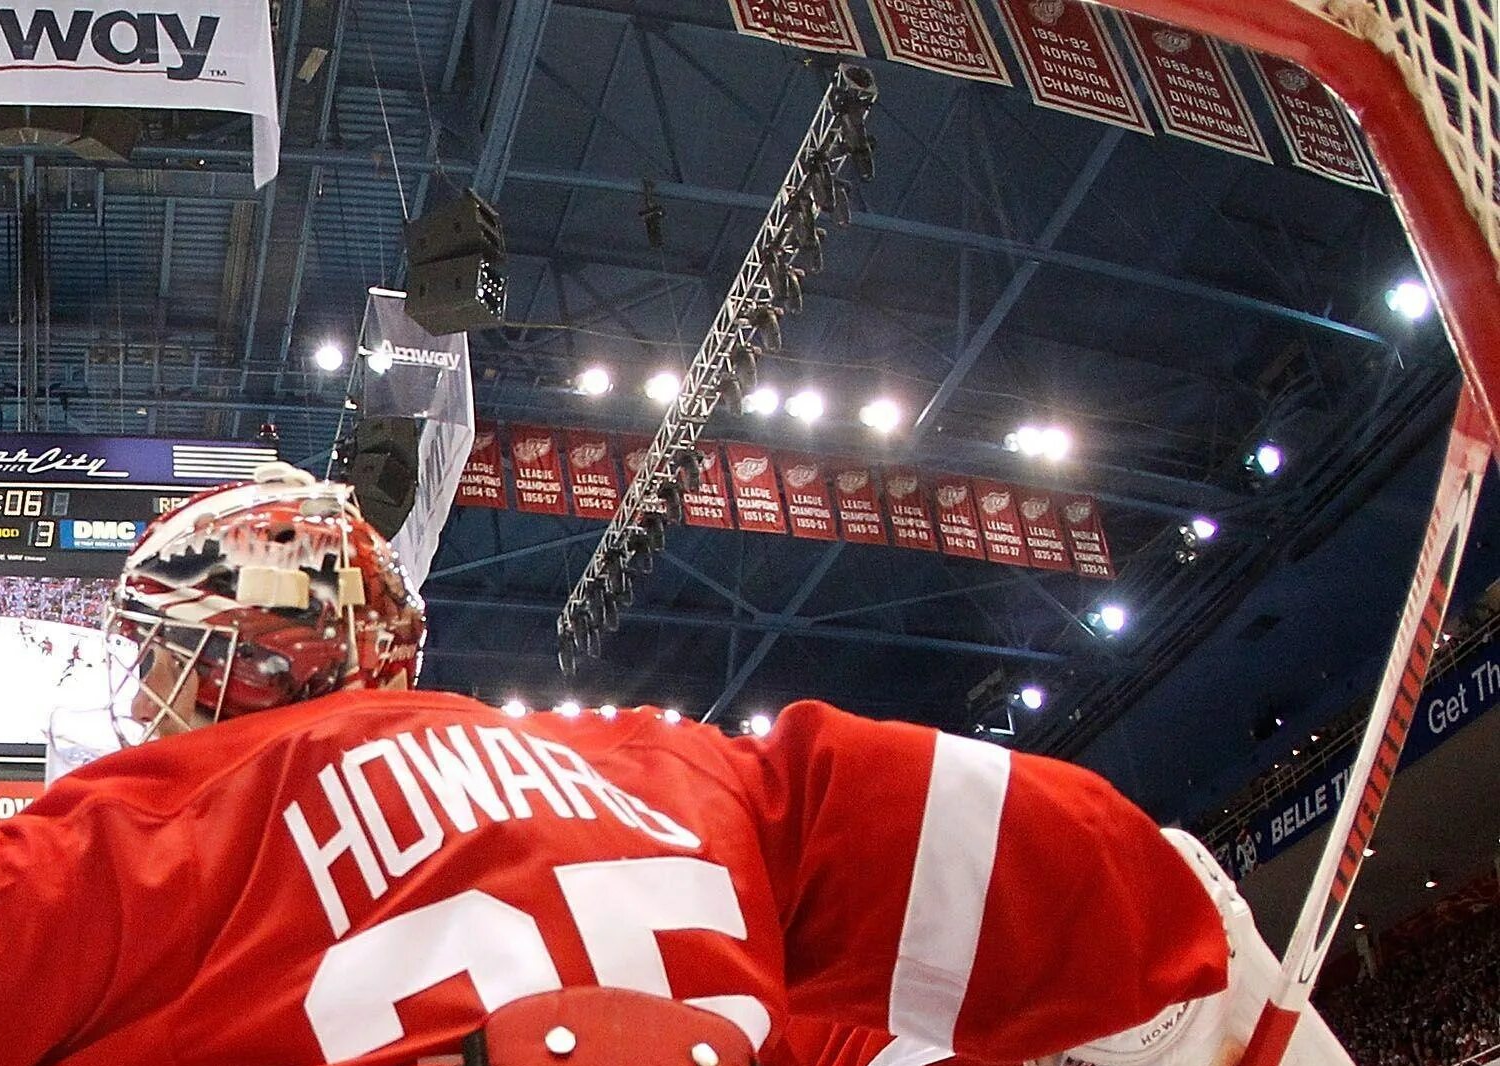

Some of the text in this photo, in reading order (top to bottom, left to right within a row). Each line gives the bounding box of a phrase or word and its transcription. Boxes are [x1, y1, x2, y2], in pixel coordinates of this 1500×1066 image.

[900, 14, 967, 38] REGULAR
[909, 28, 969, 51] SEASON
[1039, 44, 1098, 70] NORRIS
[1043, 60, 1111, 90] DIVISION
[1166, 73, 1221, 99] NORRIS
[1041, 76, 1127, 109] CHAMPIONS
[1169, 89, 1233, 119] DIVISION
[1170, 105, 1248, 138] CHAMPIONS
[516, 479, 562, 493] CHAMPIONS
[519, 467, 555, 480] LEAGUE
[576, 473, 611, 486] LEAGUE
[572, 485, 618, 499] CHAMPIONS
[736, 498, 779, 512] CHAMPIONS
[739, 487, 772, 500] LEAGUE
[35, 521, 56, 547] 3
[73, 521, 137, 540] DMC
[1427, 682, 1469, 735] Get
[1271, 783, 1329, 846] BELLE
[282, 724, 703, 941] HOWARD
